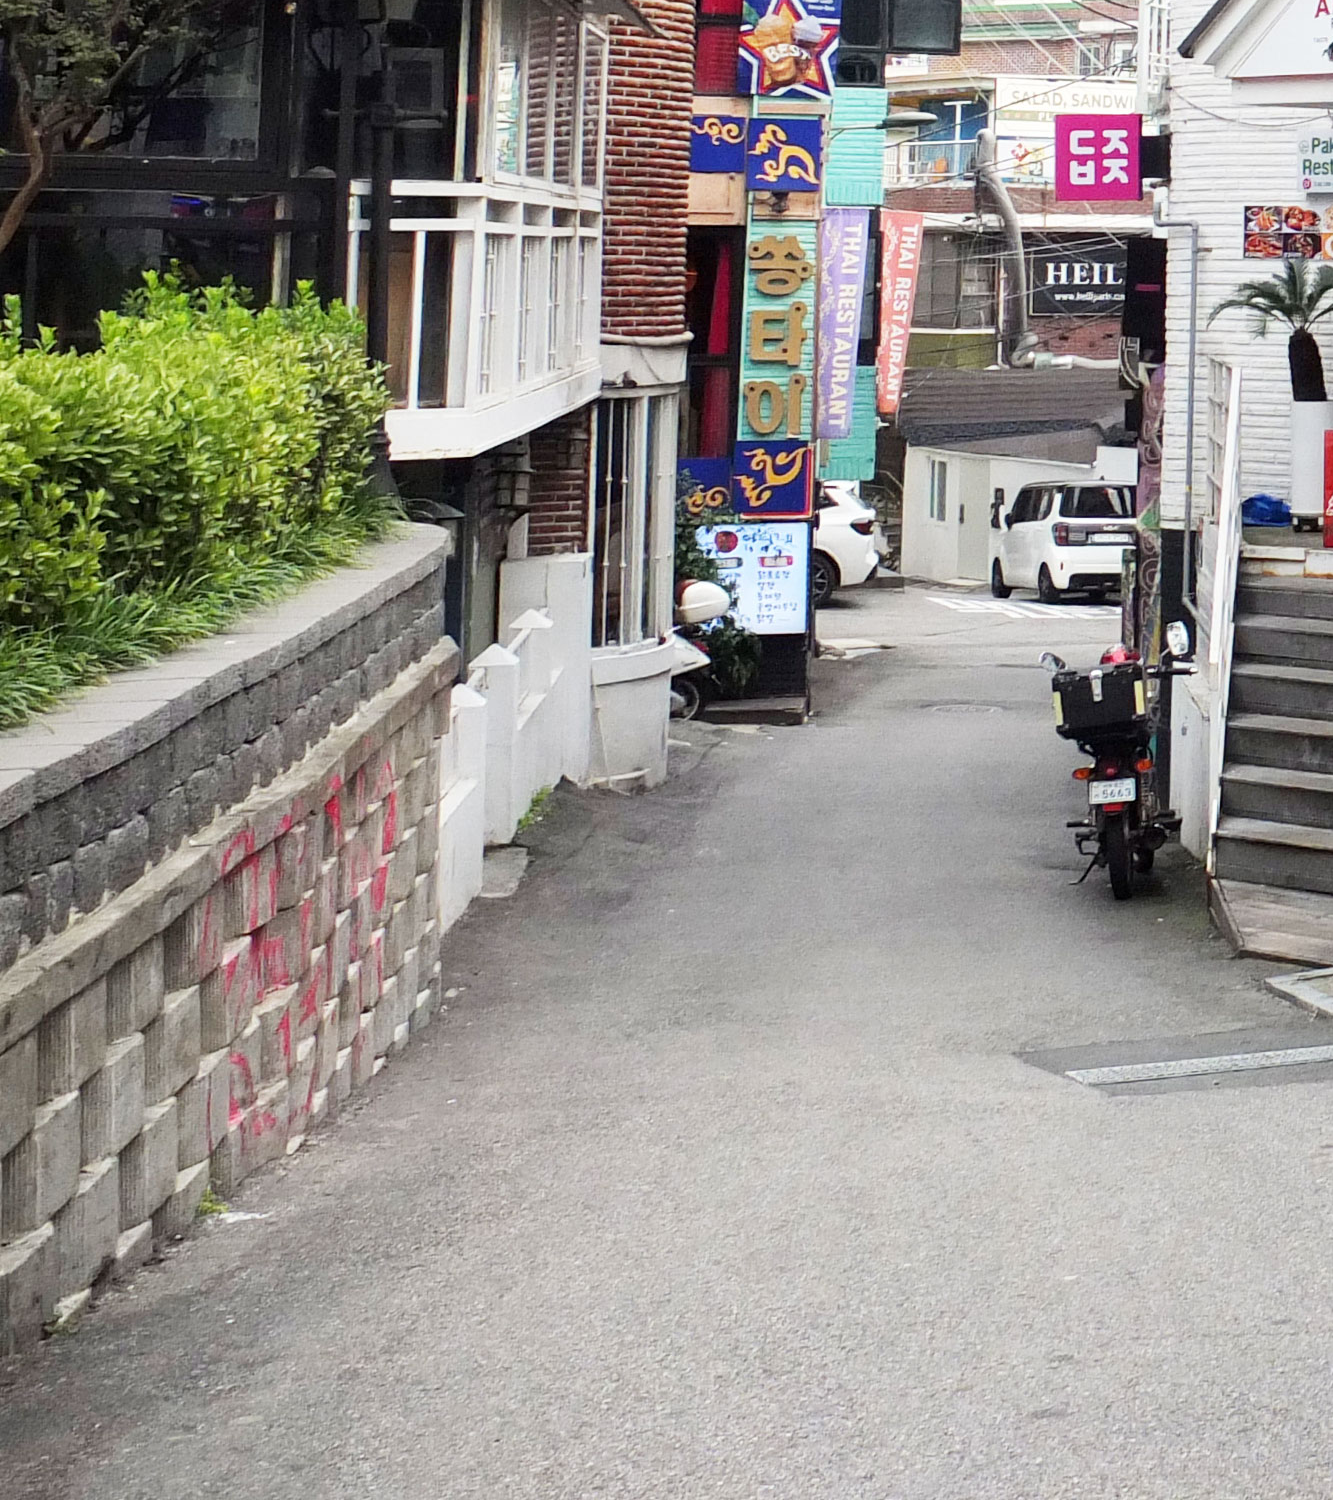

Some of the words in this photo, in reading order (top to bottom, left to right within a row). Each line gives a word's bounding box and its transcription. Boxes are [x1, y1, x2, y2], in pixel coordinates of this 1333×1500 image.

[841, 222, 863, 275] THAI
[897, 223, 920, 270] THAI
[828, 283, 859, 430] RESTAURANT
[885, 276, 913, 405] RESTAURANT
